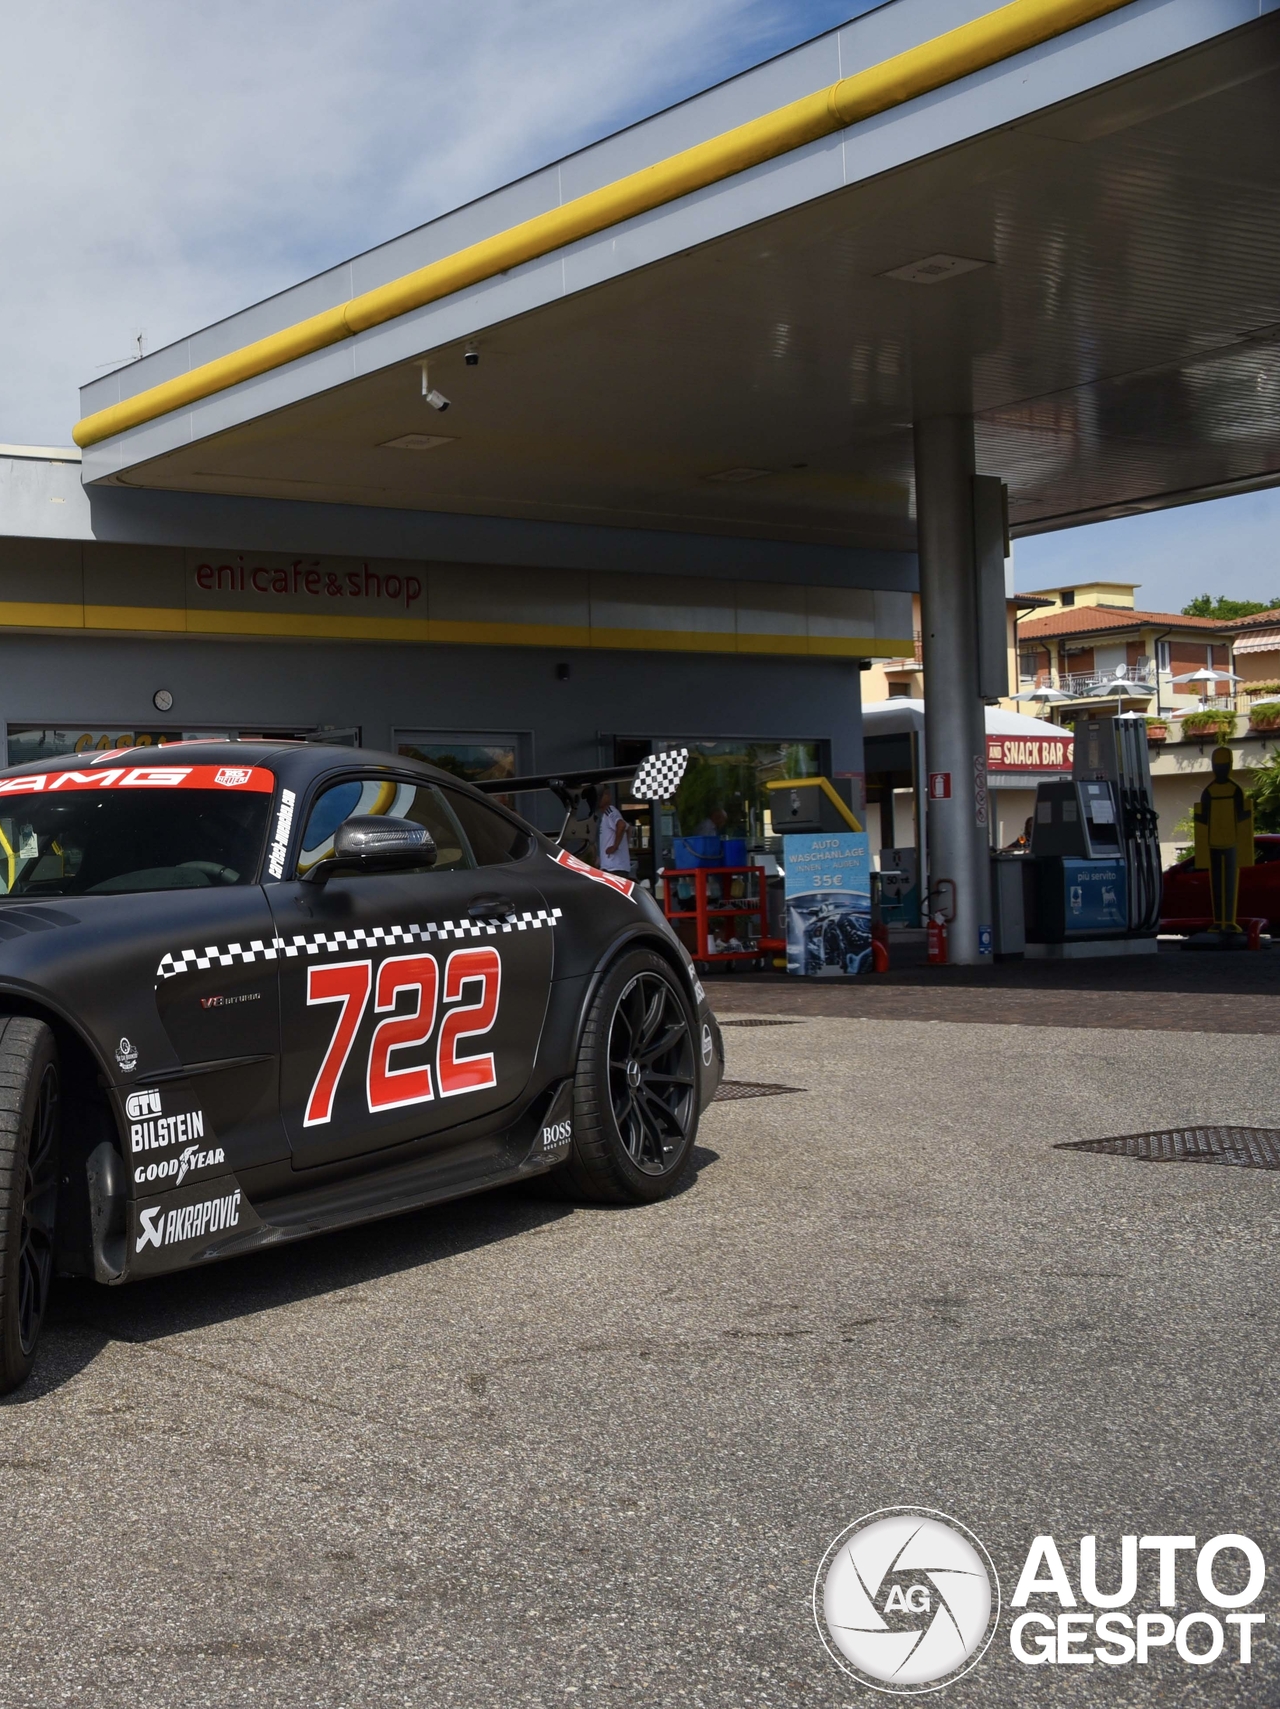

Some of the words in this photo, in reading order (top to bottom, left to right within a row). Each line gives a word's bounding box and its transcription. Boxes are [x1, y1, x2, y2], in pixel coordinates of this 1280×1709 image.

[195, 555, 245, 591] eni
[989, 746, 1002, 759] AND
[1003, 741, 1040, 765] SNACK
[1042, 742, 1064, 765] BAR
[812, 839, 840, 850] AUTO
[788, 848, 865, 863] WASCHANLAGE
[796, 864, 822, 872] INNEN
[812, 874, 843, 887] 35€
[1077, 871, 1090, 883] più
[1091, 870, 1117, 881] servito
[201, 995, 224, 1009] V8
[303, 945, 502, 1128] 722
[130, 1110, 204, 1153] BILSTEIN
[543, 1120, 572, 1145] BOSS
